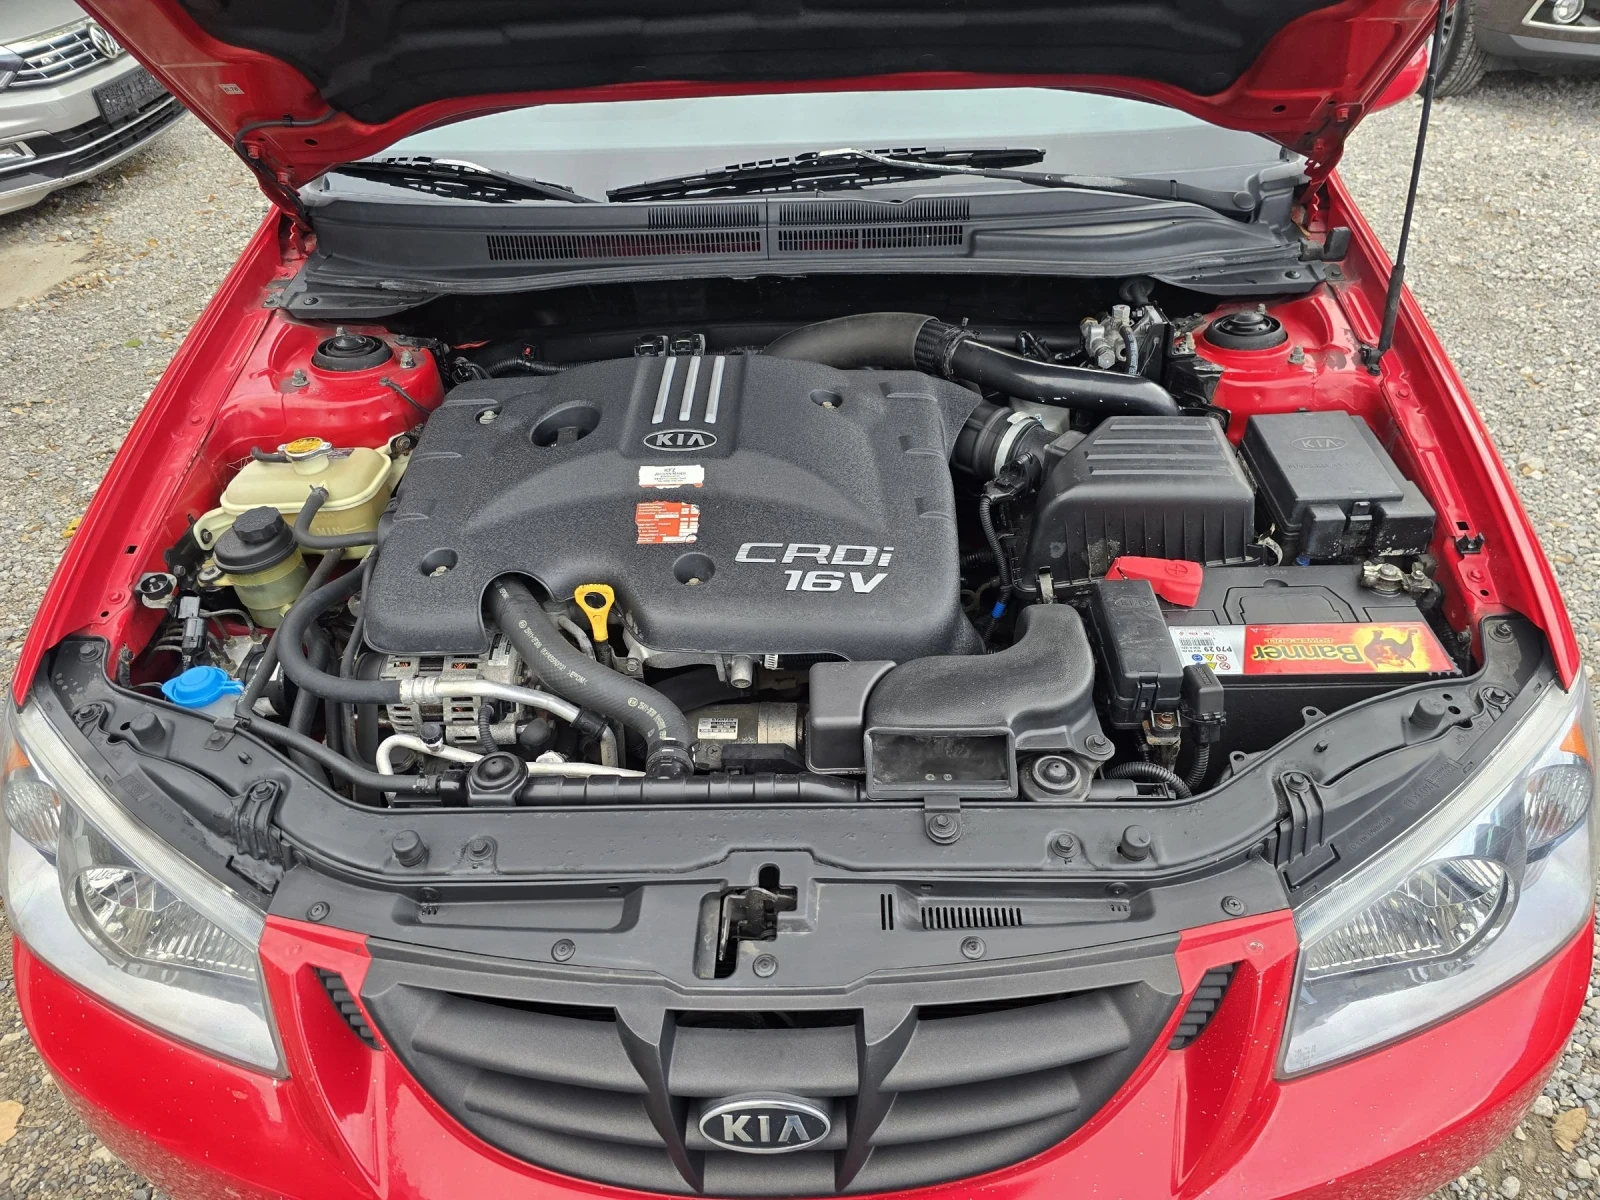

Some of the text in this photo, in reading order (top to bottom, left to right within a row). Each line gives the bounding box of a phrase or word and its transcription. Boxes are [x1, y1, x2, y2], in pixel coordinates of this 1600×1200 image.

[654, 432, 706, 448] KIA
[1301, 438, 1339, 448] KIA
[316, 526, 342, 536] MIN
[734, 541, 896, 568] CRDi
[783, 570, 889, 594] 16V
[1203, 645, 1215, 653] 29
[1215, 645, 1233, 654] P70
[1251, 643, 1365, 663] Banner
[721, 1114, 811, 1143] KIA
